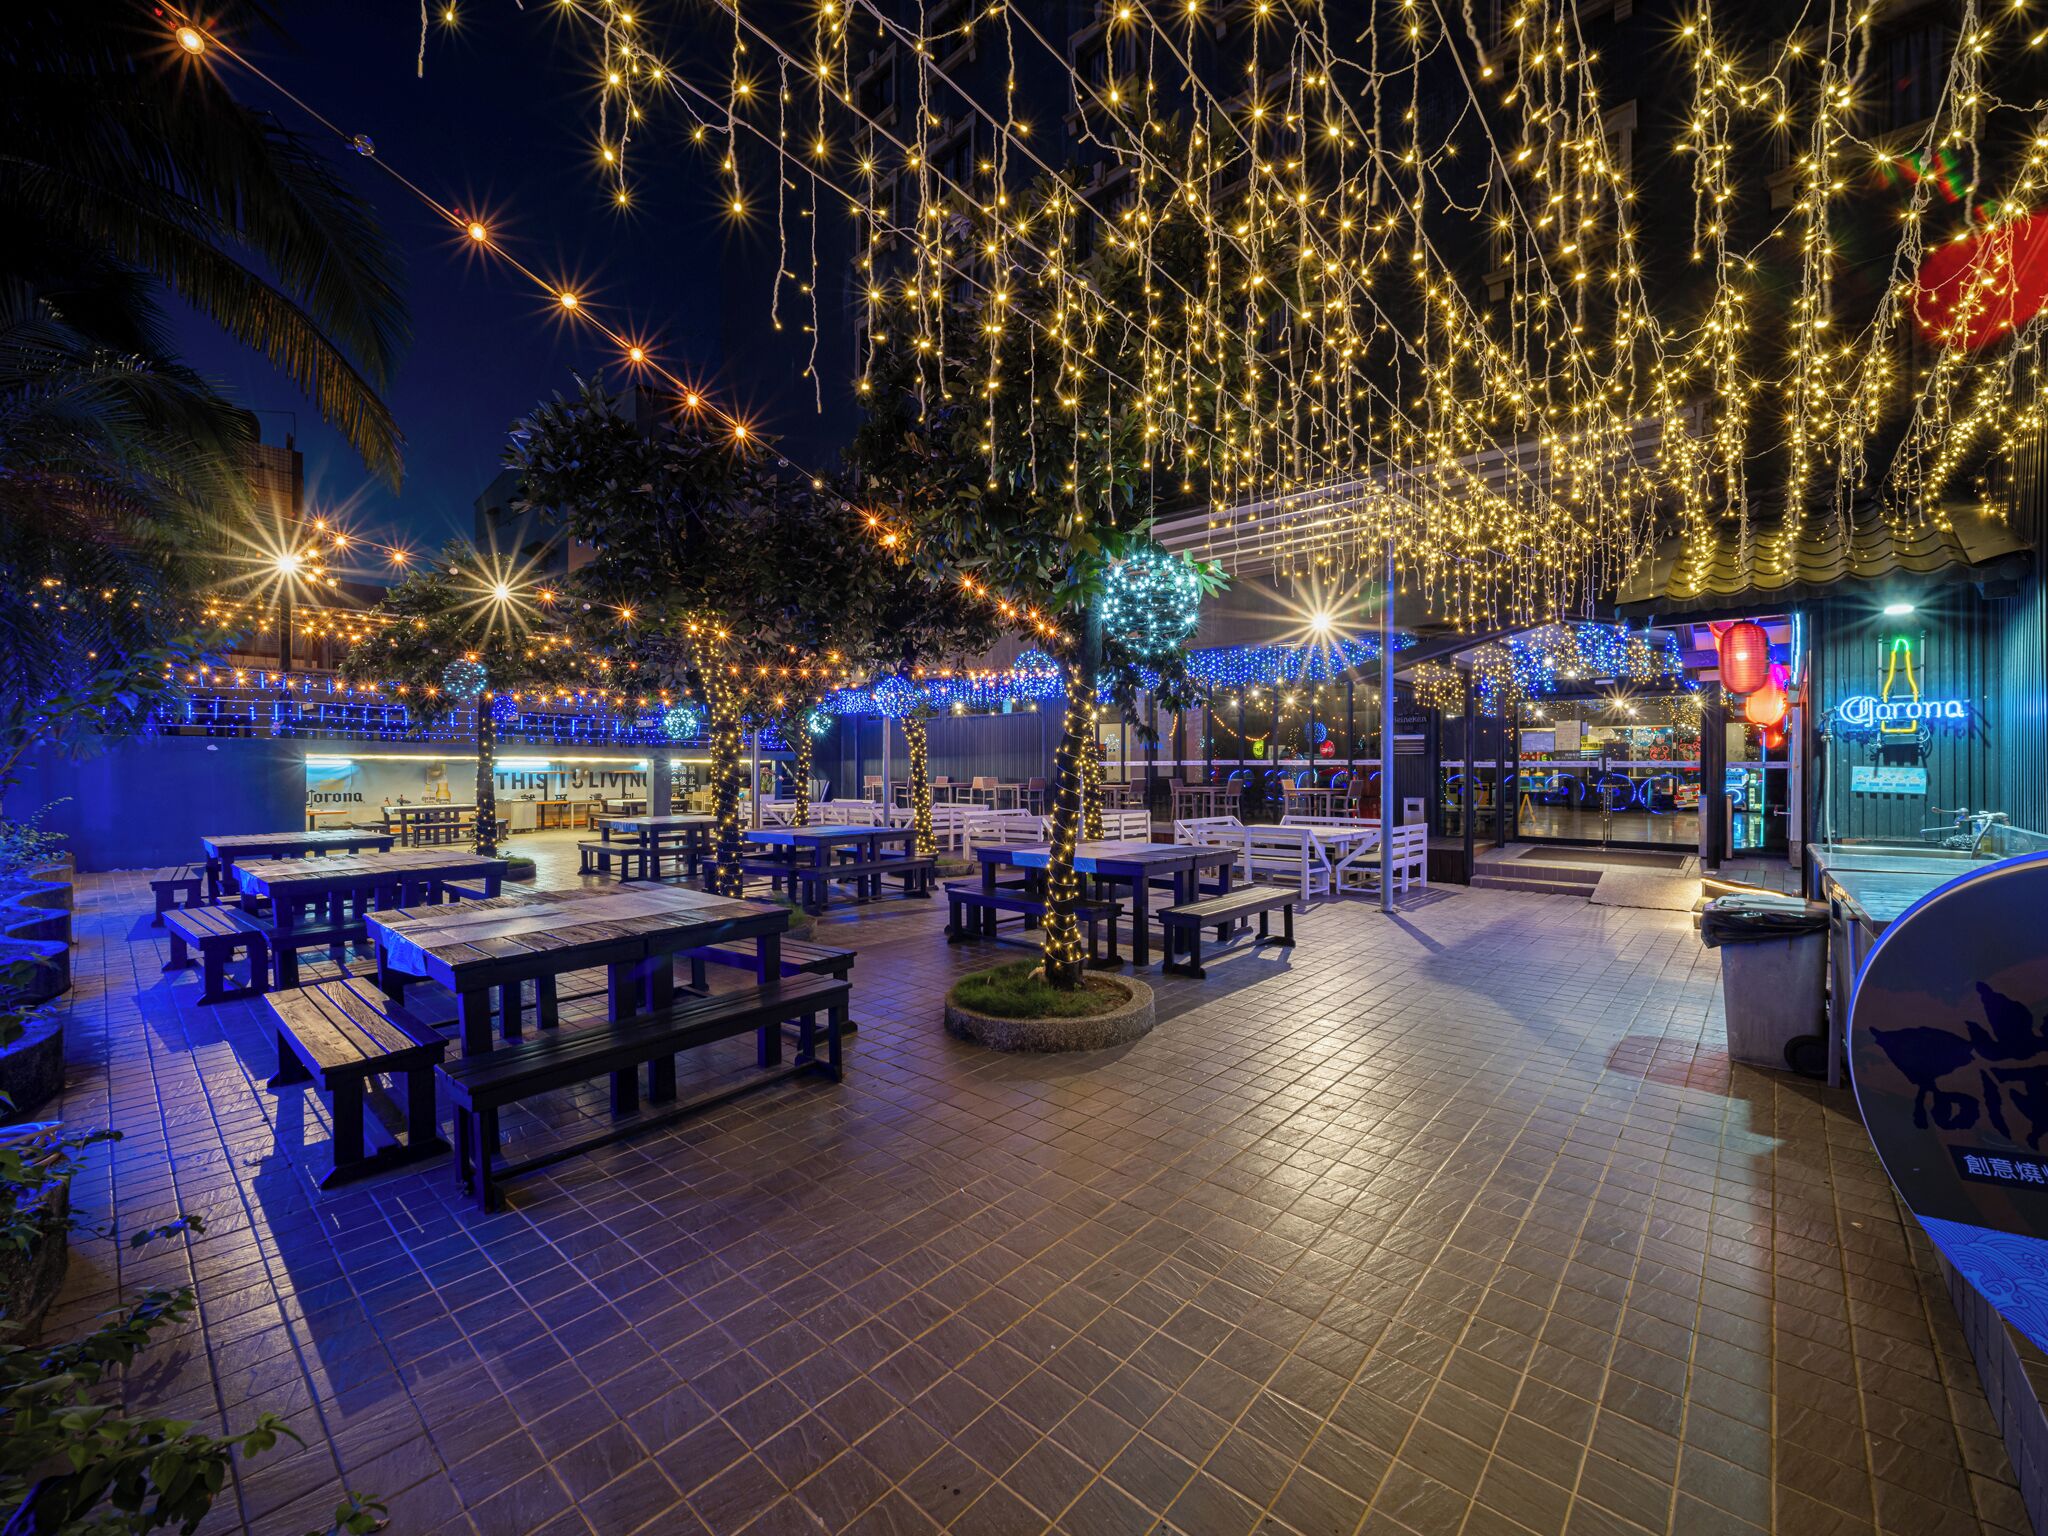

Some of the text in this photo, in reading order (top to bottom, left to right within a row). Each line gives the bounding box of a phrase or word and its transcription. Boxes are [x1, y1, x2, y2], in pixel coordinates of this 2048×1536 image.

[1840, 696, 1965, 727] Corona
[496, 772, 547, 790] THIS
[589, 771, 647, 788] LIVN
[1963, 1154, 2048, 1184] 創意燒
